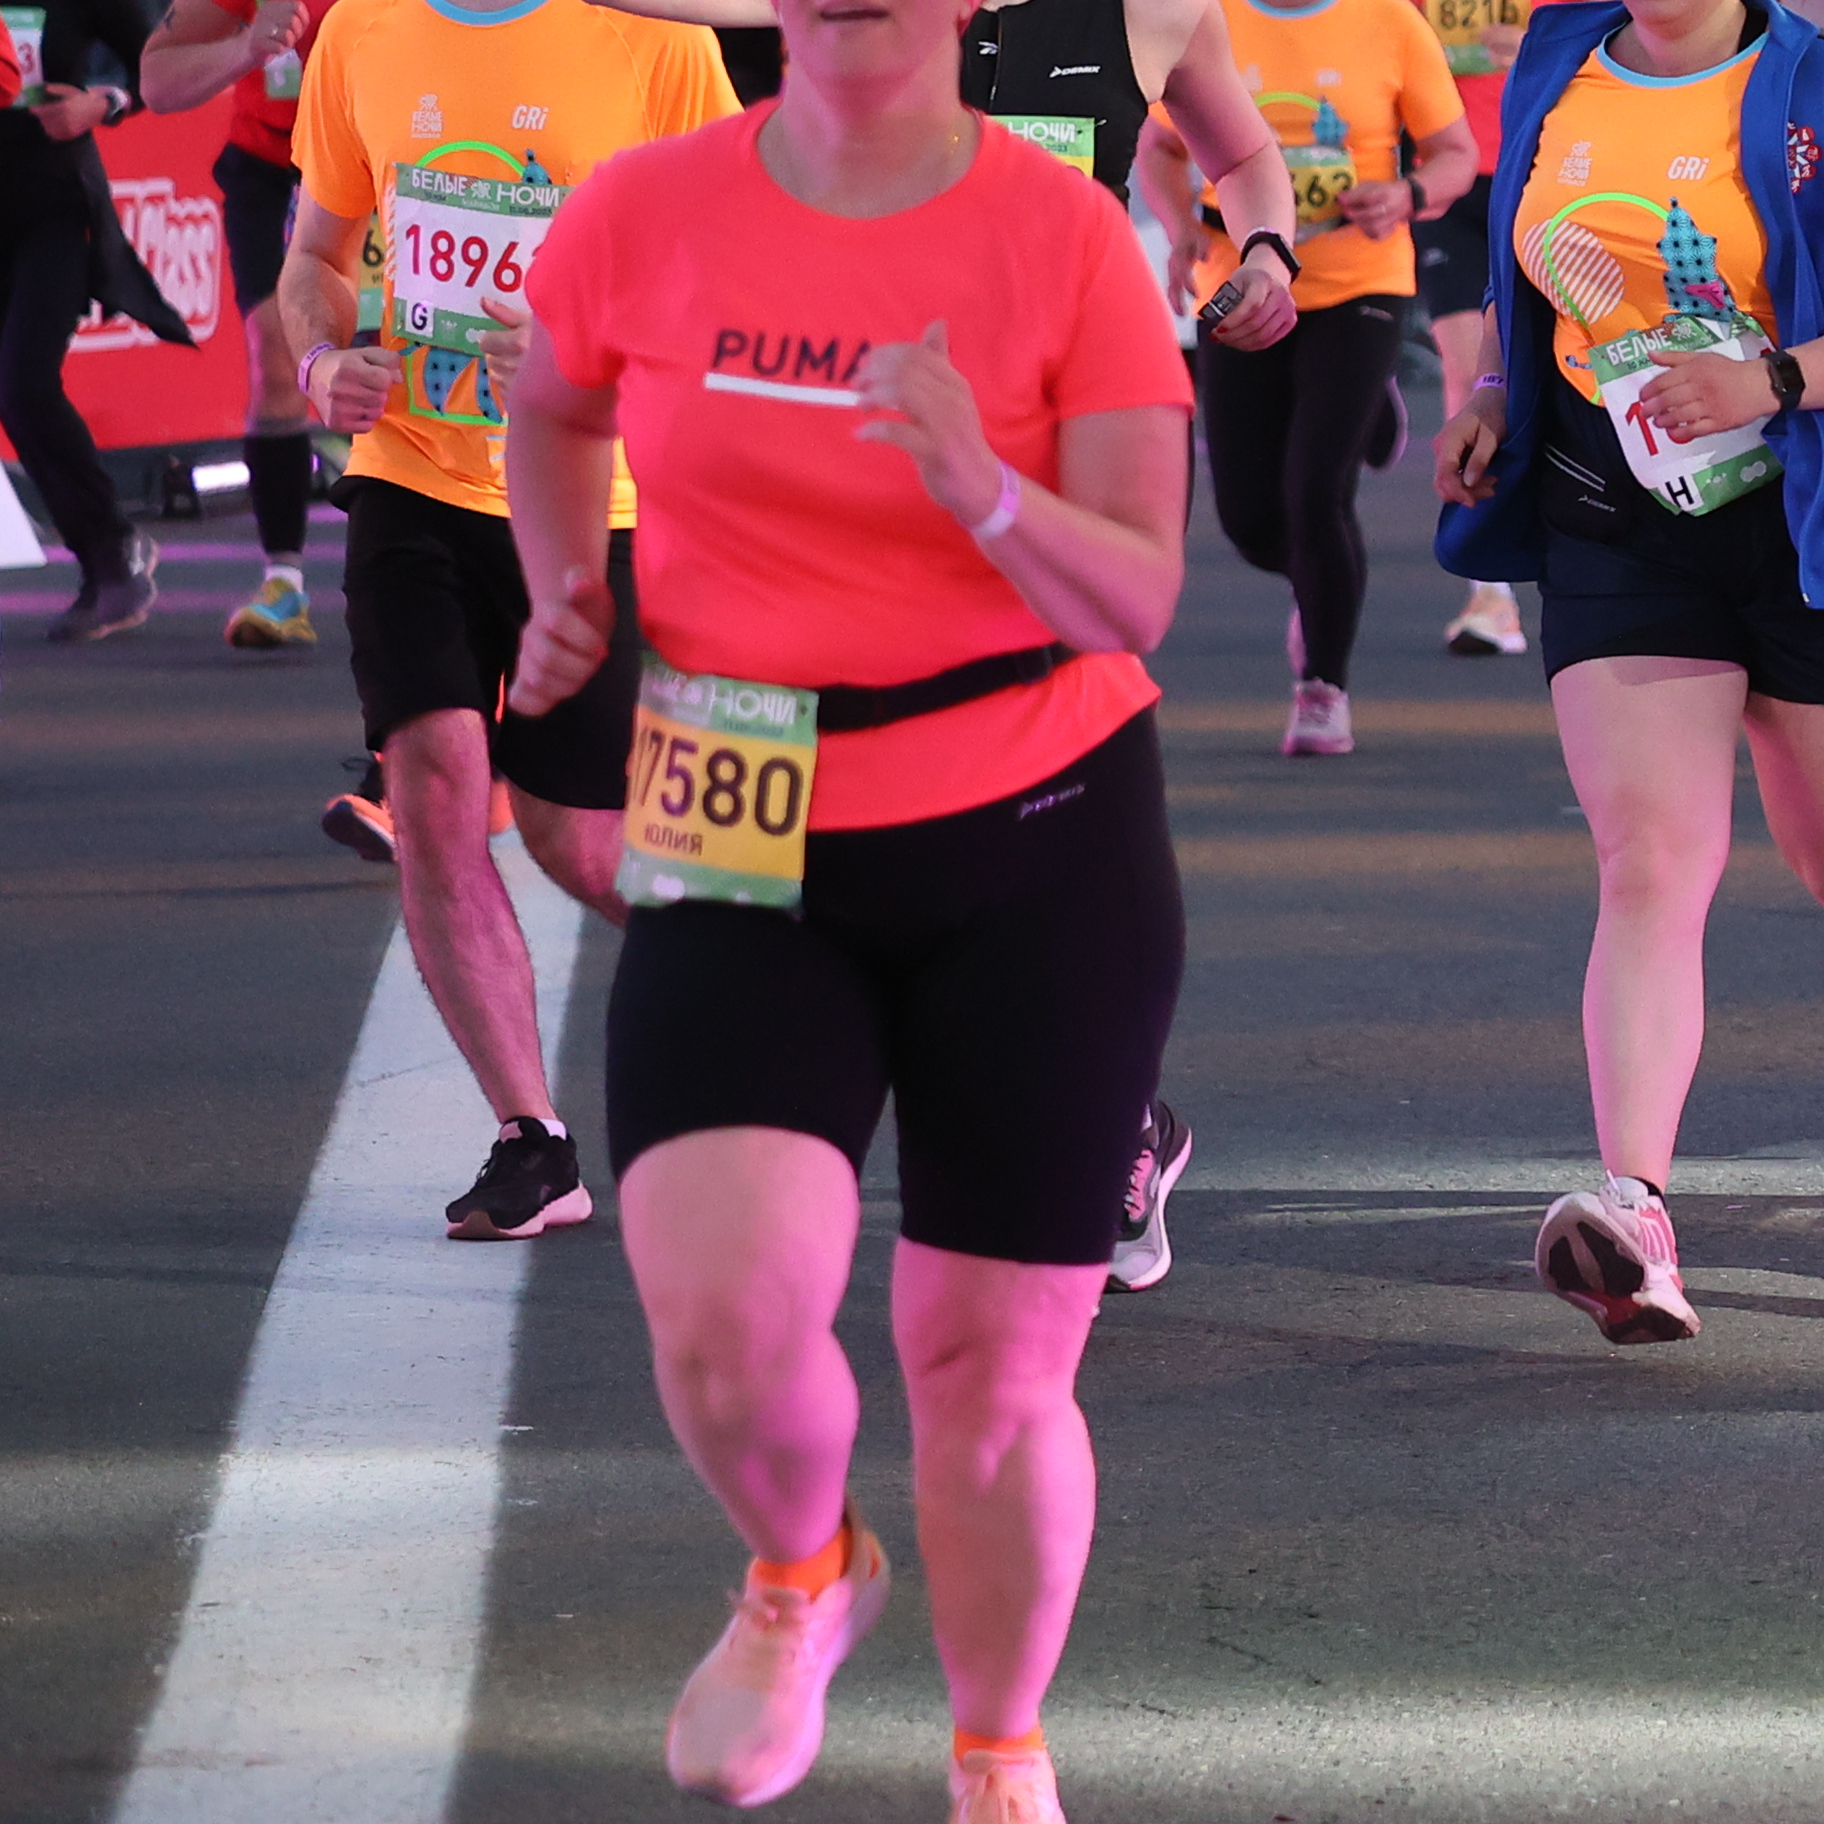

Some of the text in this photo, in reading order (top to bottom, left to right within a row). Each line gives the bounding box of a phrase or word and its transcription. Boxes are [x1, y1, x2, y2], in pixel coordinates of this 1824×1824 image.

[1667, 155, 1710, 181] GRi
[411, 168, 560, 208] БЕЛЫЕ НОЧИ
[405, 223, 542, 293] 1896
[411, 302, 428, 331] G
[1605, 327, 1673, 366] БЕЛЫЕ
[1665, 475, 1695, 508] H
[644, 822, 703, 856] ЮЛИЯ
